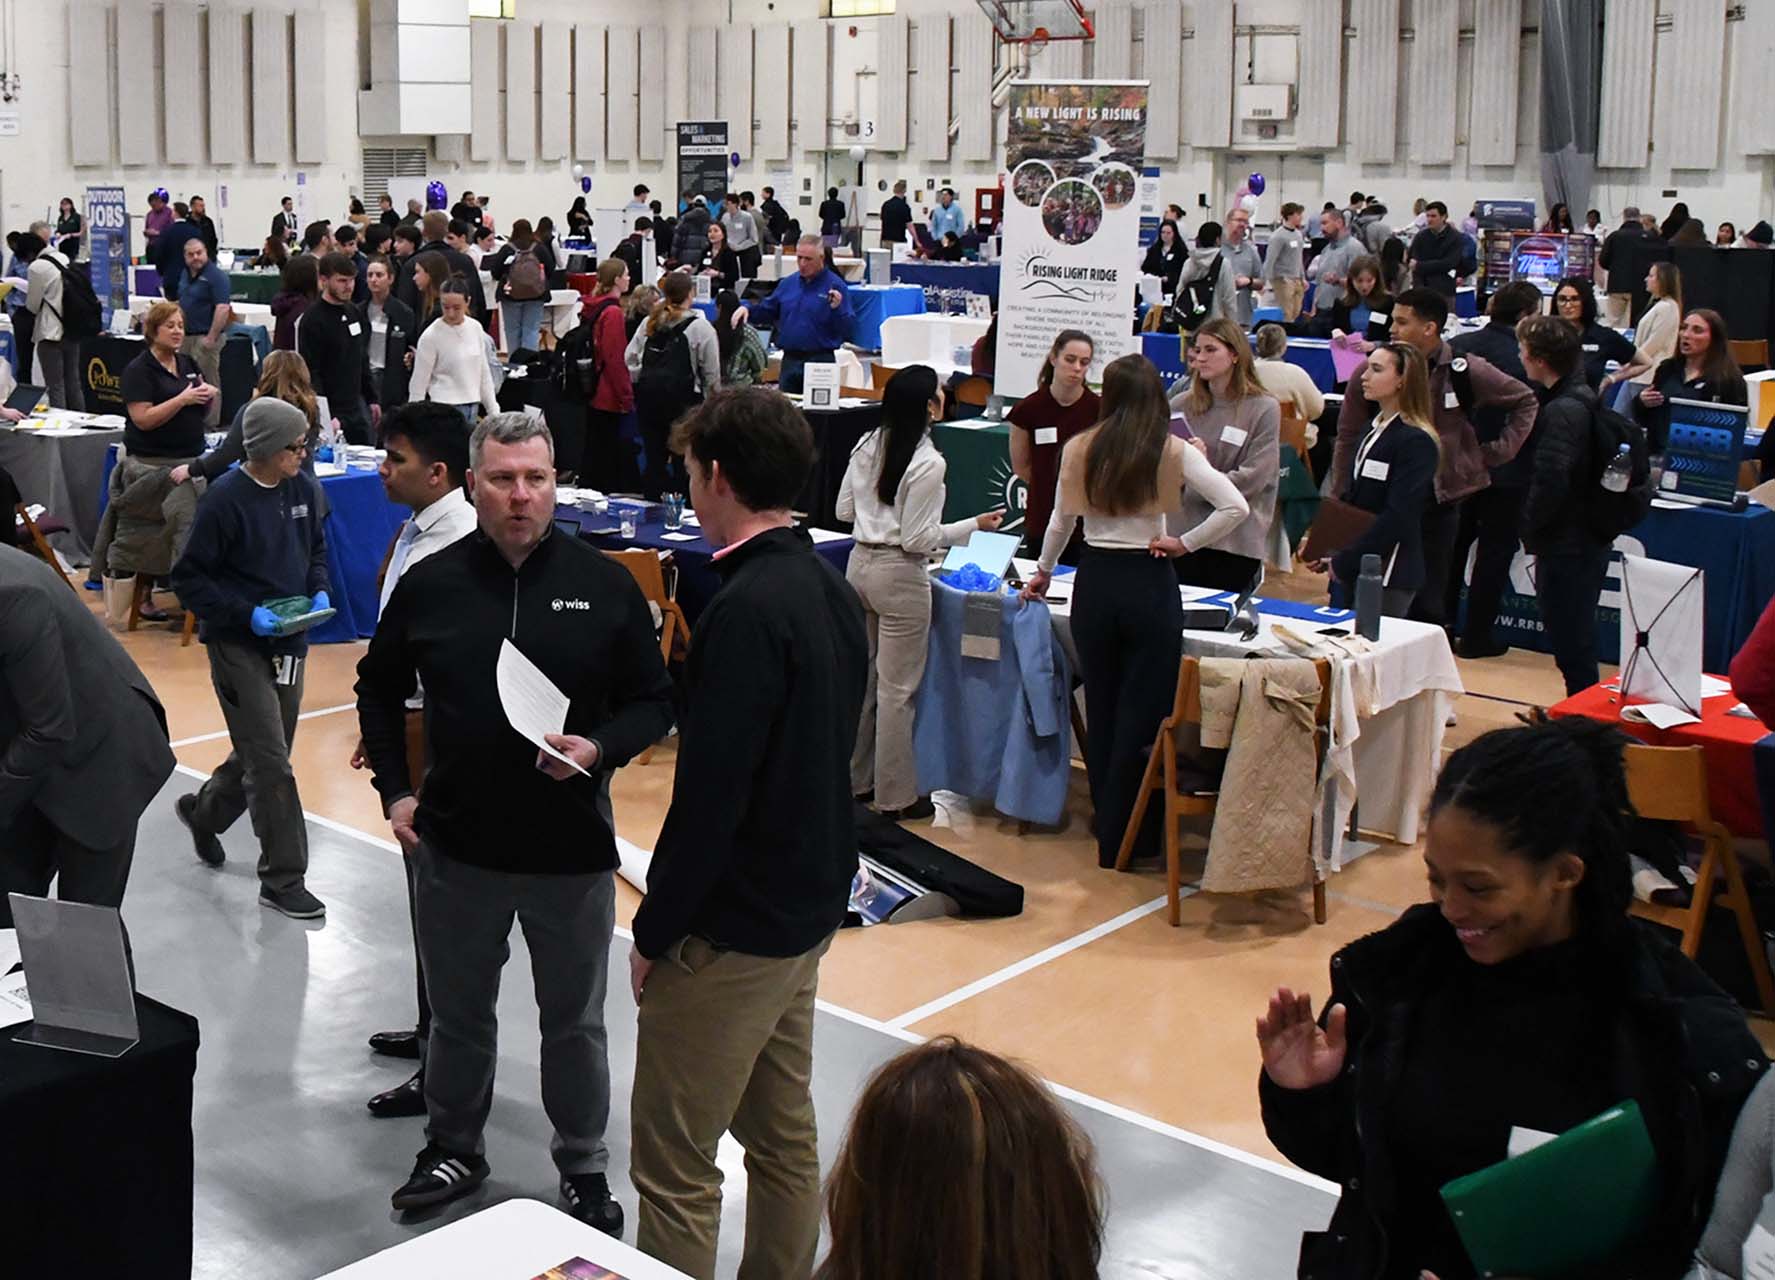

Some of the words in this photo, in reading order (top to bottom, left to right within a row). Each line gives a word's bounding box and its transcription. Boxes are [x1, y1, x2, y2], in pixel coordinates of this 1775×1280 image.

[1015, 106, 1023, 119] A
[1026, 106, 1049, 119] NEW
[1053, 106, 1083, 119] LIGHT
[1087, 106, 1097, 120] IS
[1101, 107, 1140, 120] RISING
[680, 125, 698, 134] SALES
[865, 121, 873, 136] 3
[691, 134, 725, 144] MARKETING
[87, 205, 124, 227] JOBS
[1032, 265, 1062, 279] RISING
[1064, 267, 1088, 280] LIGHT
[1090, 268, 1117, 282] RIDGE
[1043, 307, 1079, 316] COMMUNITY
[565, 598, 590, 610] wiss
